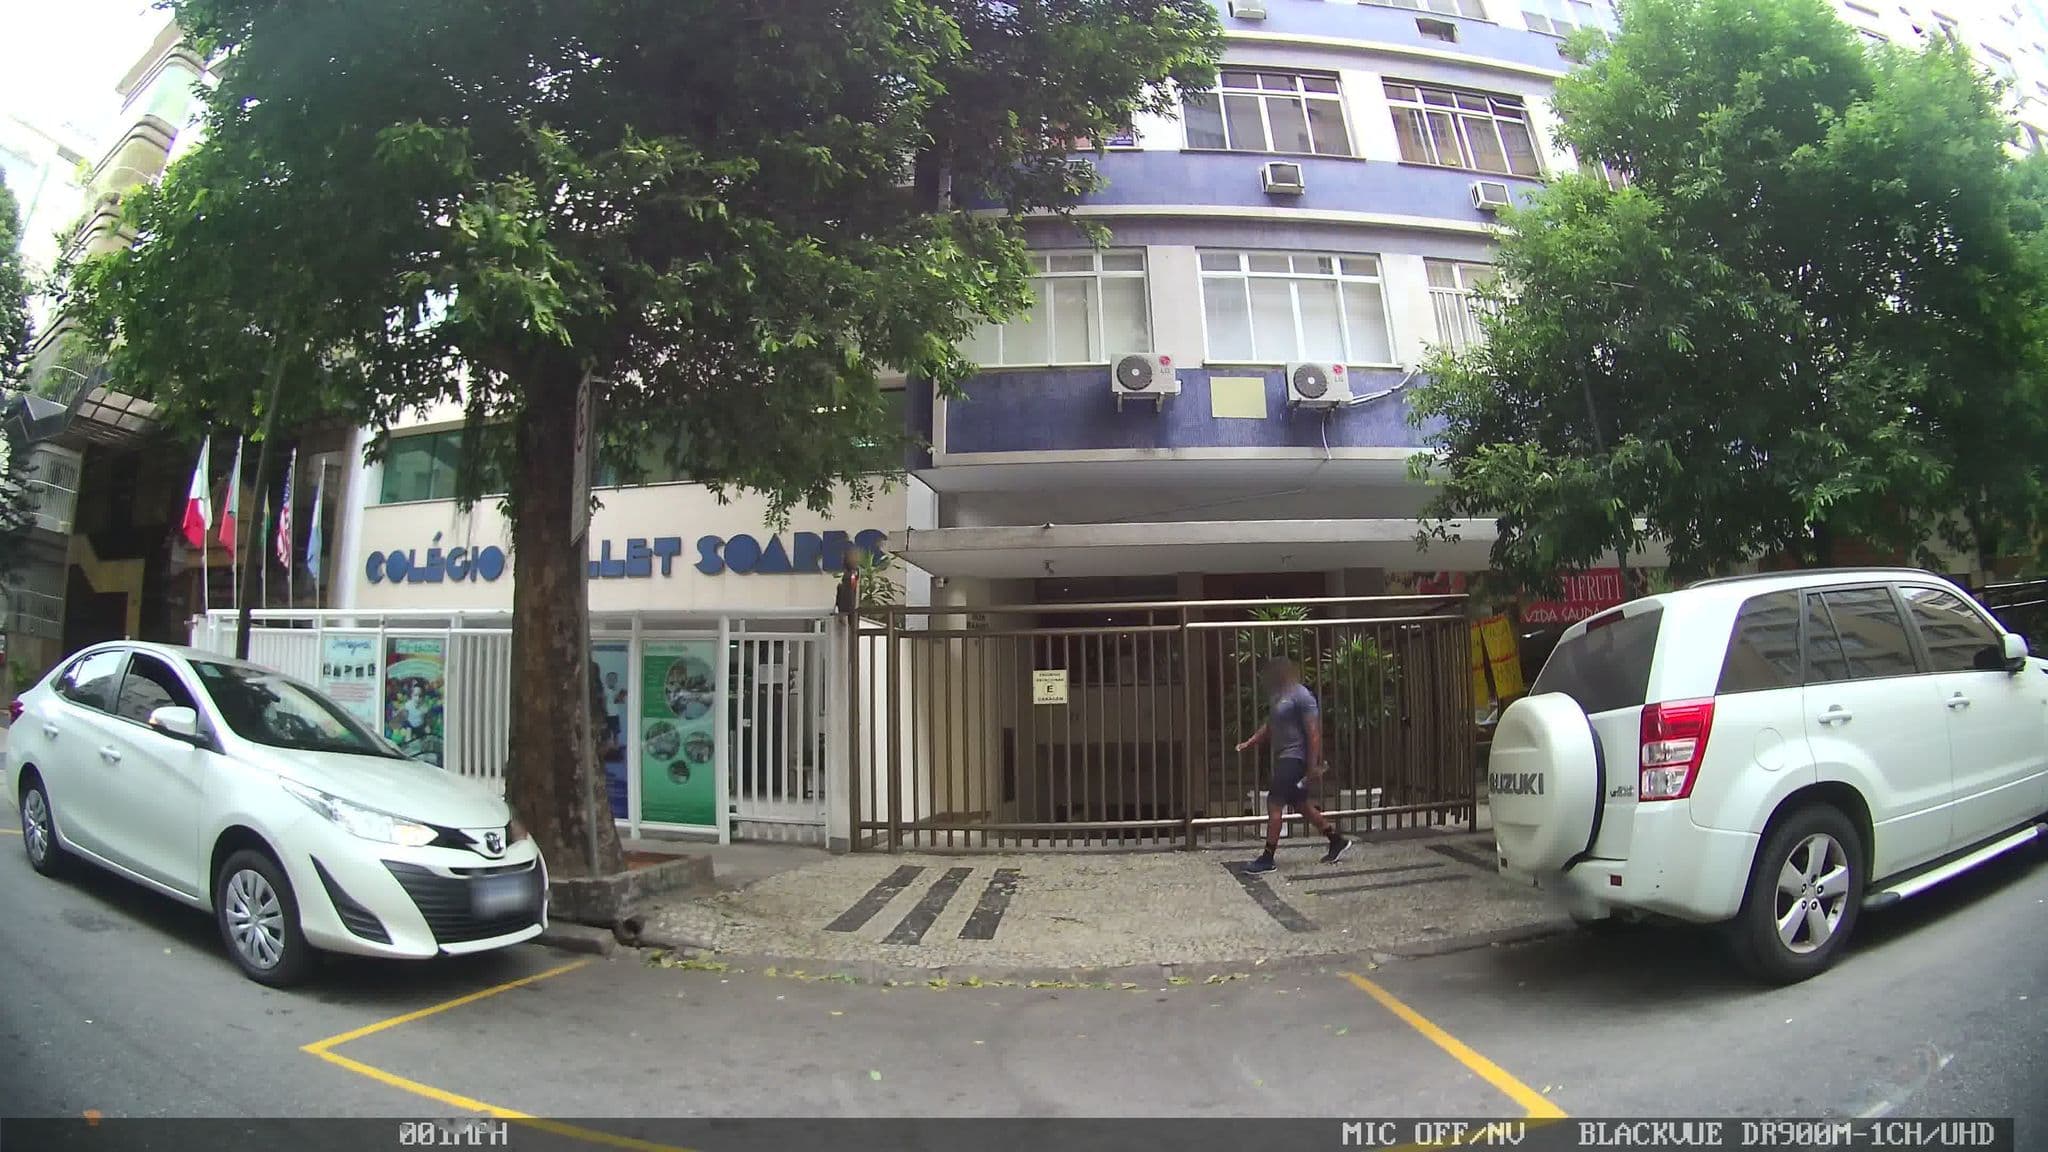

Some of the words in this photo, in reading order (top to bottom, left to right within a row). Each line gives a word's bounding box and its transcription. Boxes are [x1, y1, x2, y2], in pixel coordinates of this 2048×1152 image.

[366, 531, 506, 584] COLÉGIO
[588, 536, 682, 578] LET
[1524, 608, 1558, 623] VIDA
[1489, 772, 1545, 795] SUZUKI
